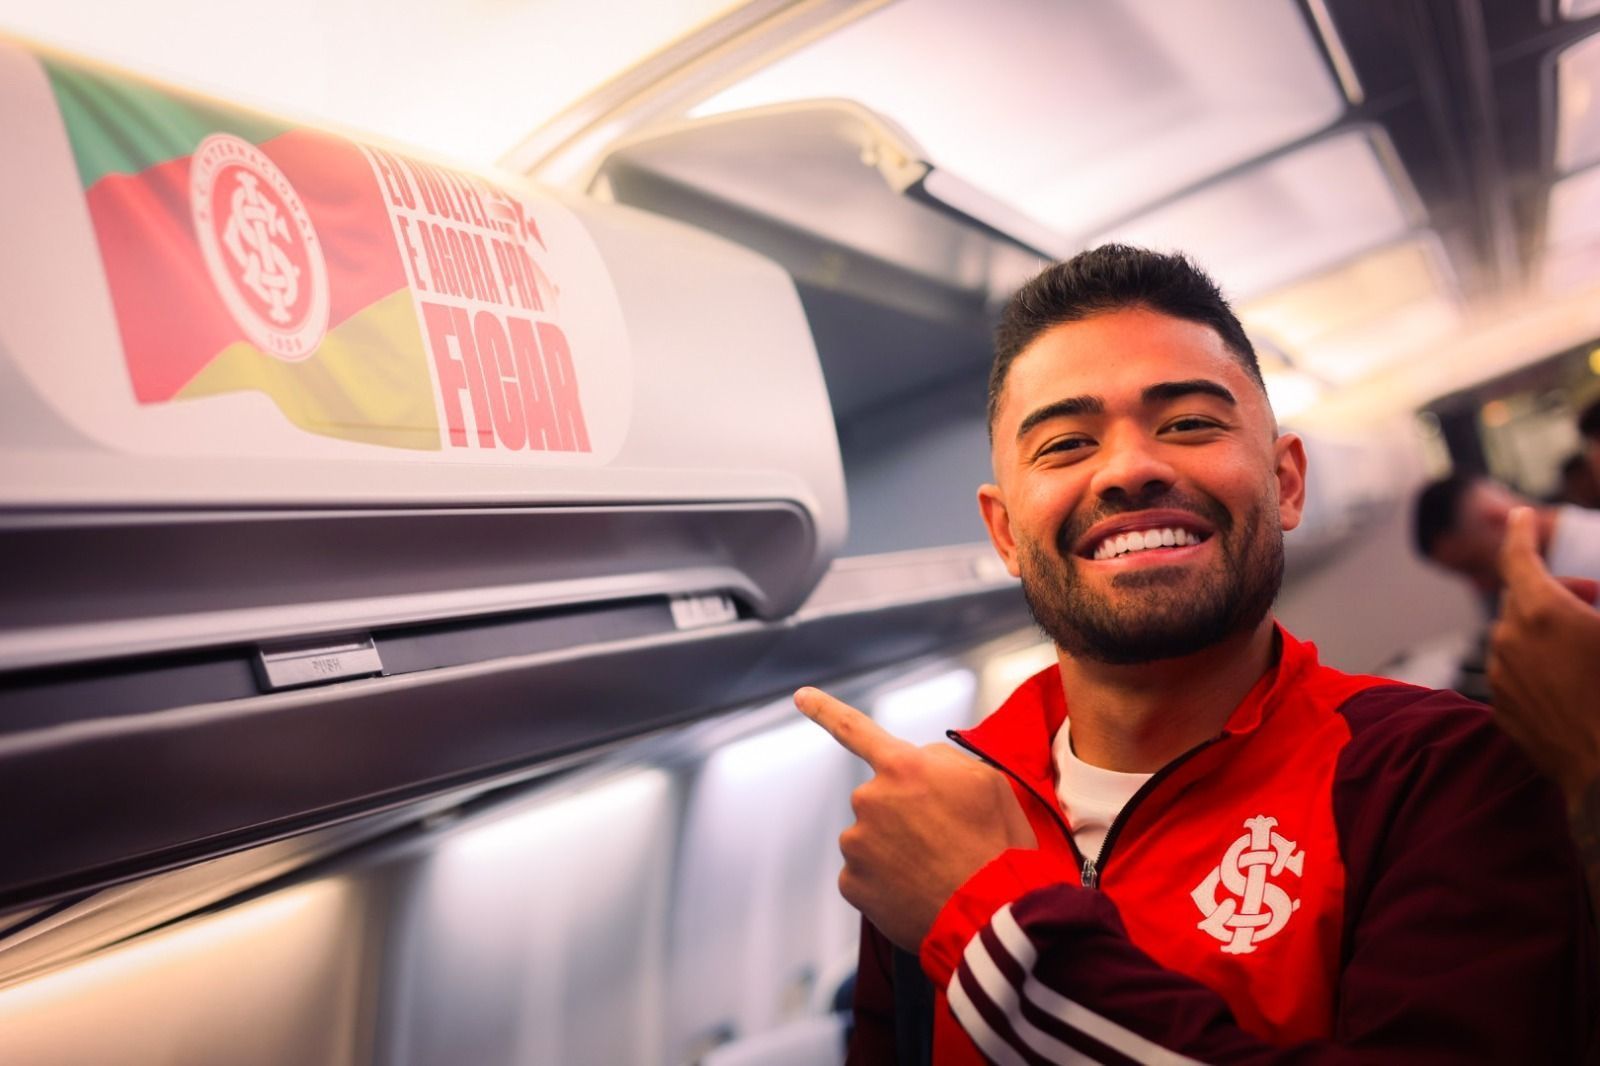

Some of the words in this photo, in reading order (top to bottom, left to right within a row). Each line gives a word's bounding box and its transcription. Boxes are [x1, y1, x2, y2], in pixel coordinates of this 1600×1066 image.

[396, 214, 427, 290] E
[417, 219, 503, 305] AGORA
[421, 301, 592, 453] FICAR
